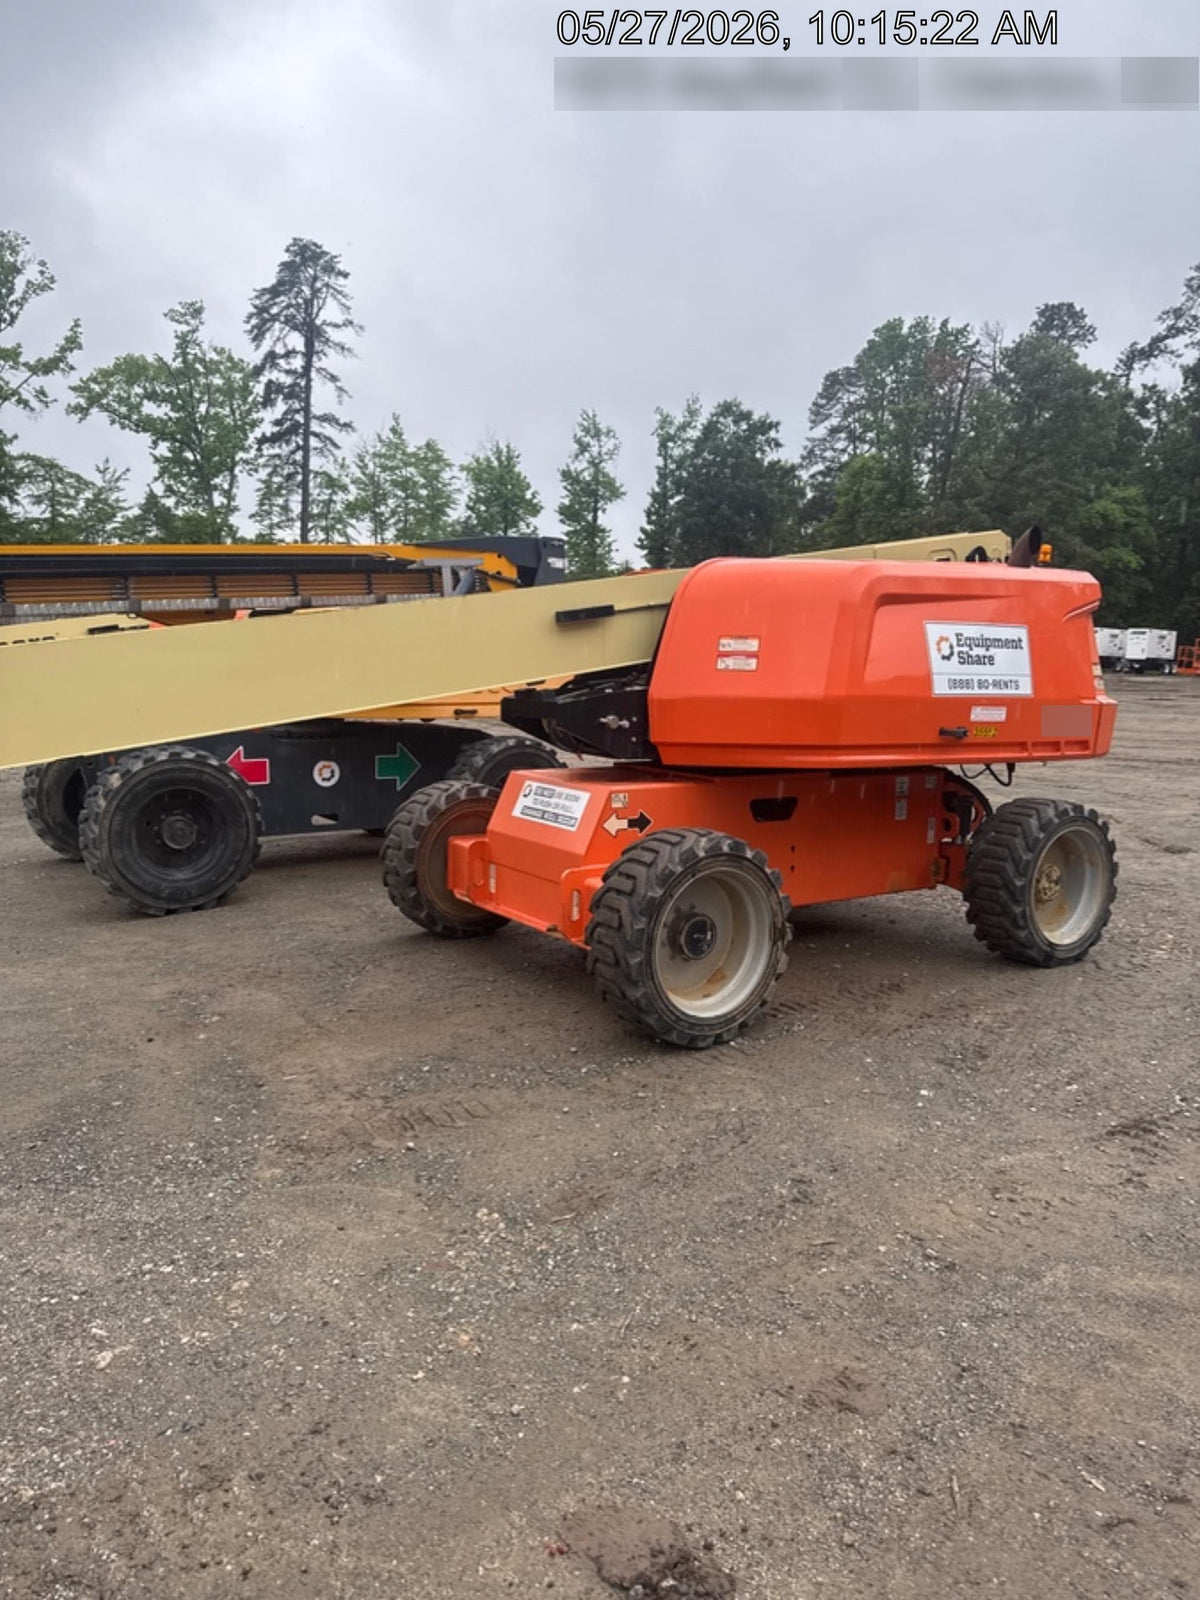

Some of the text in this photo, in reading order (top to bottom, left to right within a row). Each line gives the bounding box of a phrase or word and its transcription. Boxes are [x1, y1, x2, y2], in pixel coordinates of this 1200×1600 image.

[955, 632, 1024, 651] Equipment
[957, 650, 995, 665] Share
[947, 677, 975, 690] (888)
